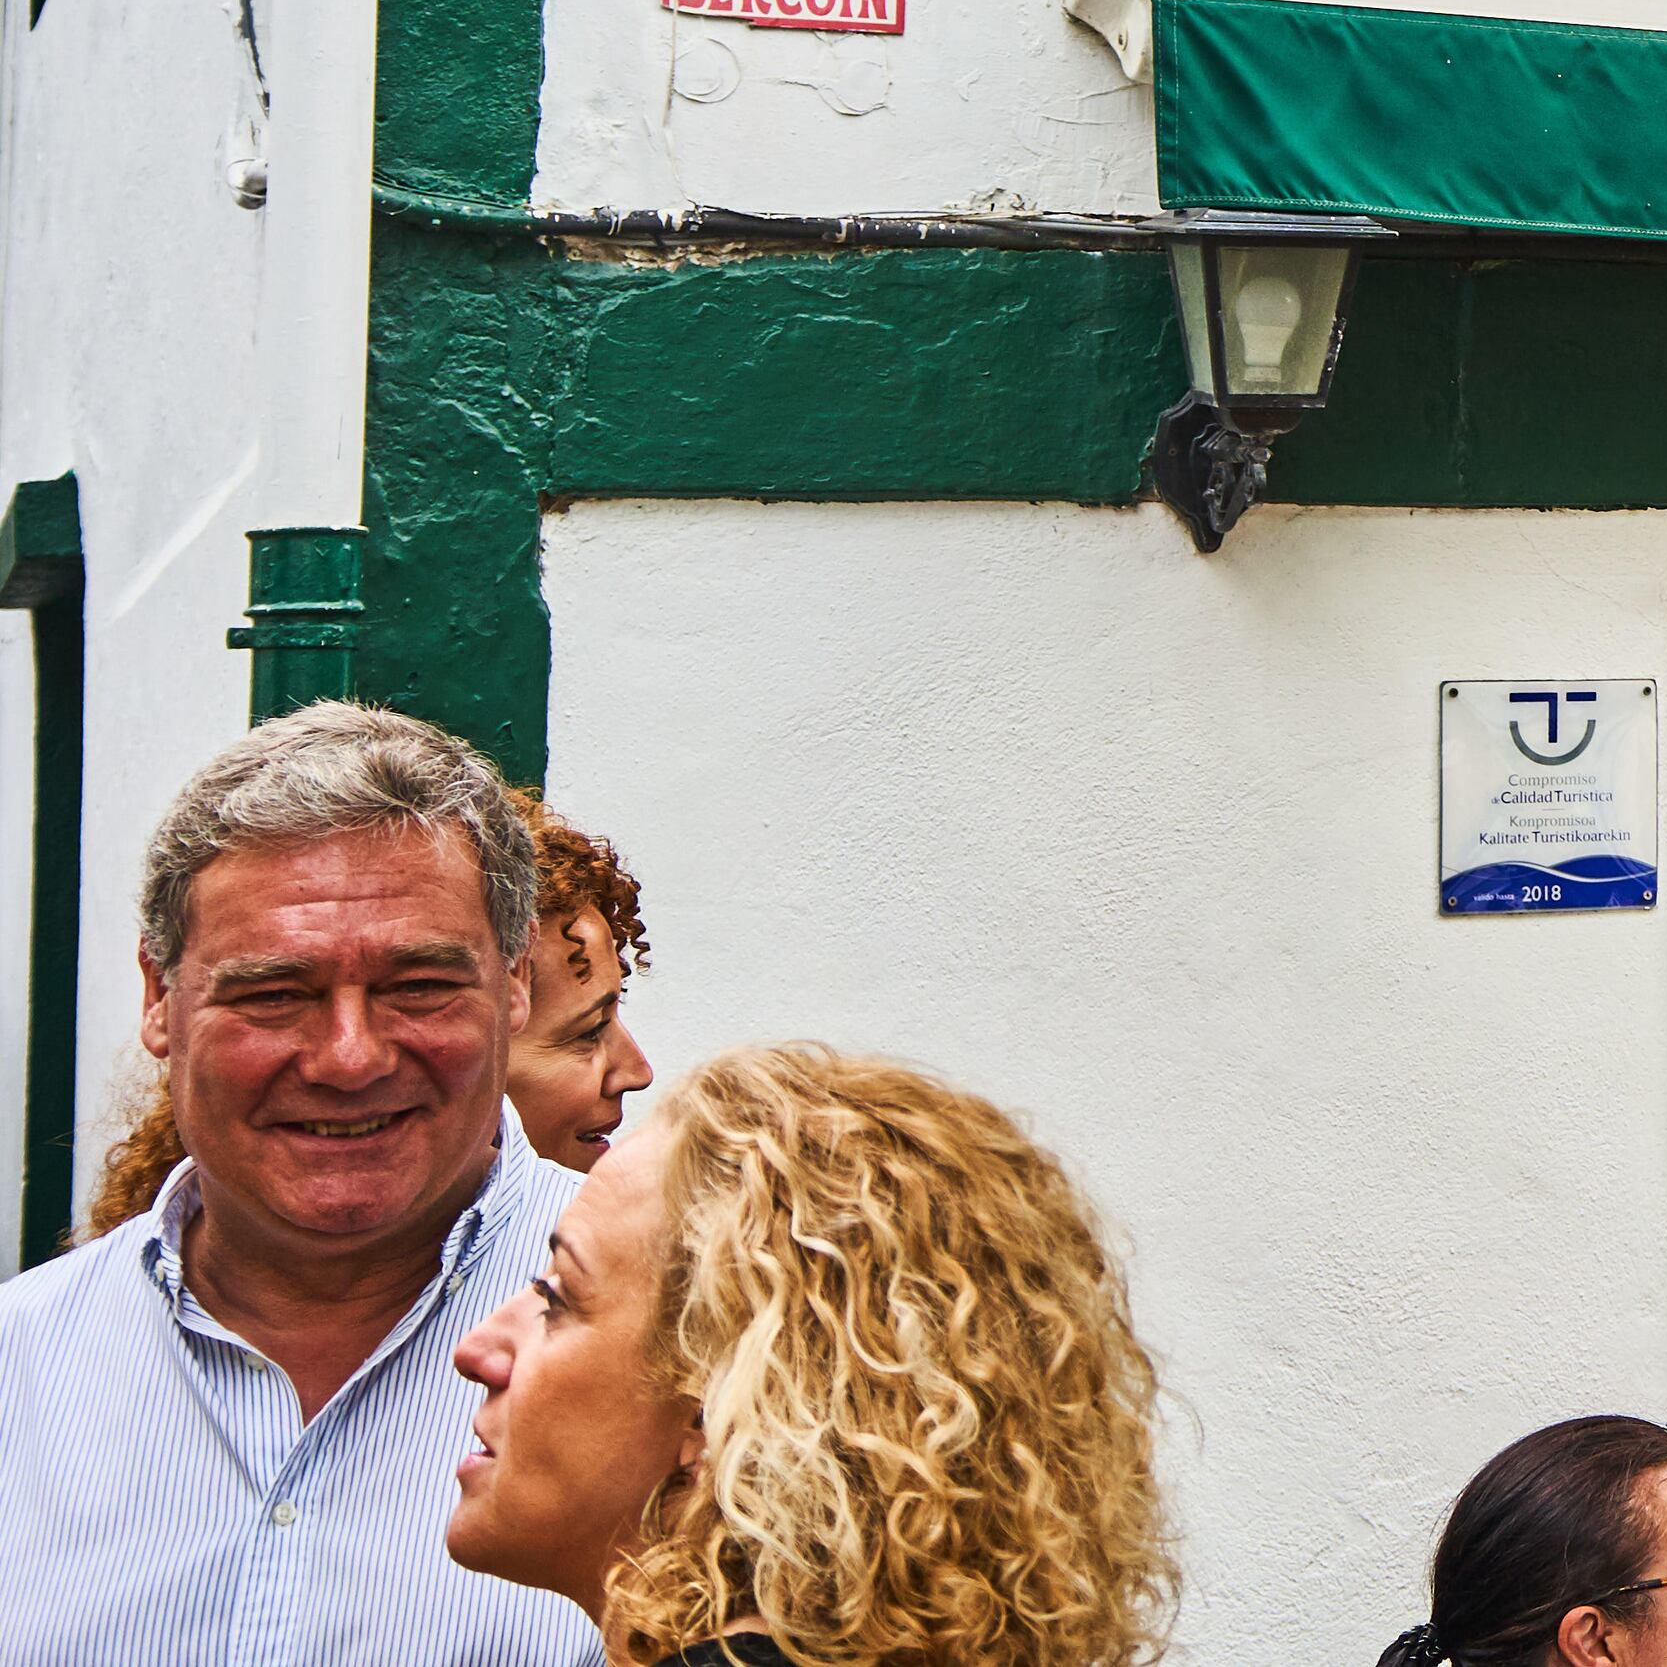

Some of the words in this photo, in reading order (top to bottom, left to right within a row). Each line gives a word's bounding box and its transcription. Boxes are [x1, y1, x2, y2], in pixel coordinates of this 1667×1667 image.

[1508, 773, 1596, 791] Compromiso
[1491, 797, 1500, 805] de
[1500, 791, 1552, 804] Calidad
[1509, 814, 1596, 830] Konpromisoa
[1479, 832, 1529, 845] Kalitate
[1532, 830, 1631, 844] Turistikoarekin
[1521, 885, 1562, 902] 2018
